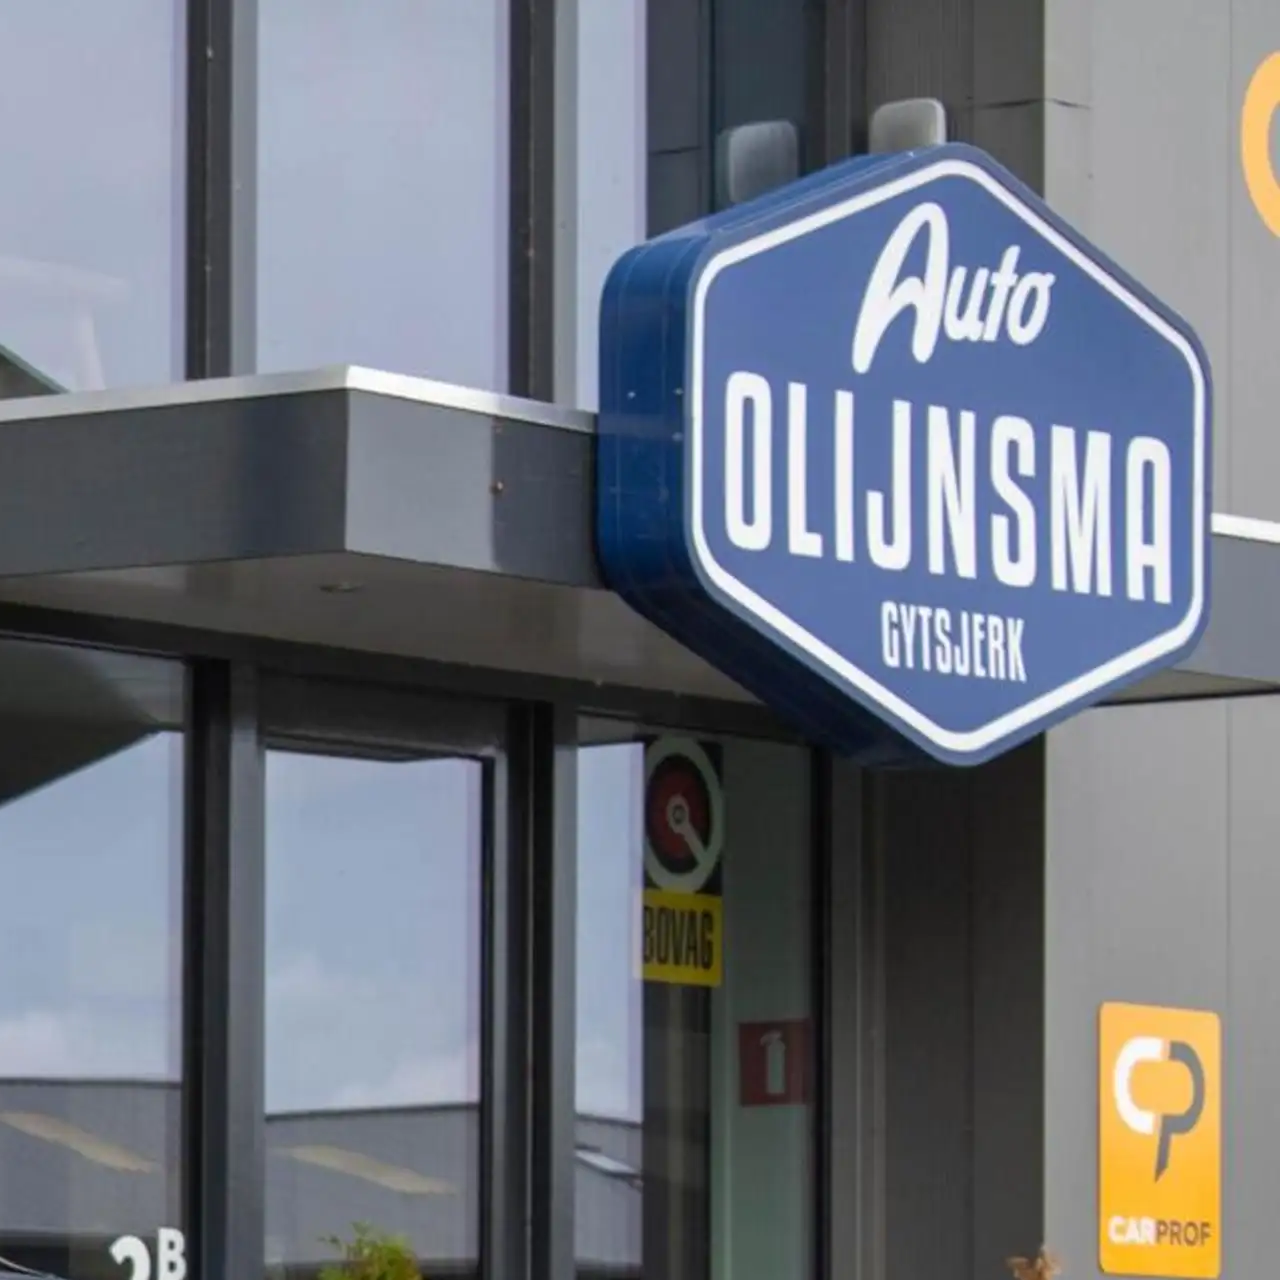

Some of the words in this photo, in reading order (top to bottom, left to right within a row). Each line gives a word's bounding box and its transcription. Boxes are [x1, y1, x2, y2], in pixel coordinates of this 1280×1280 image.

[852, 202, 1055, 374] Auto
[725, 371, 1172, 605] OLIJNSMA
[881, 600, 1027, 683] GYTSJERK
[642, 905, 714, 971] BOVAG
[1108, 1215, 1212, 1247] CARPROF
